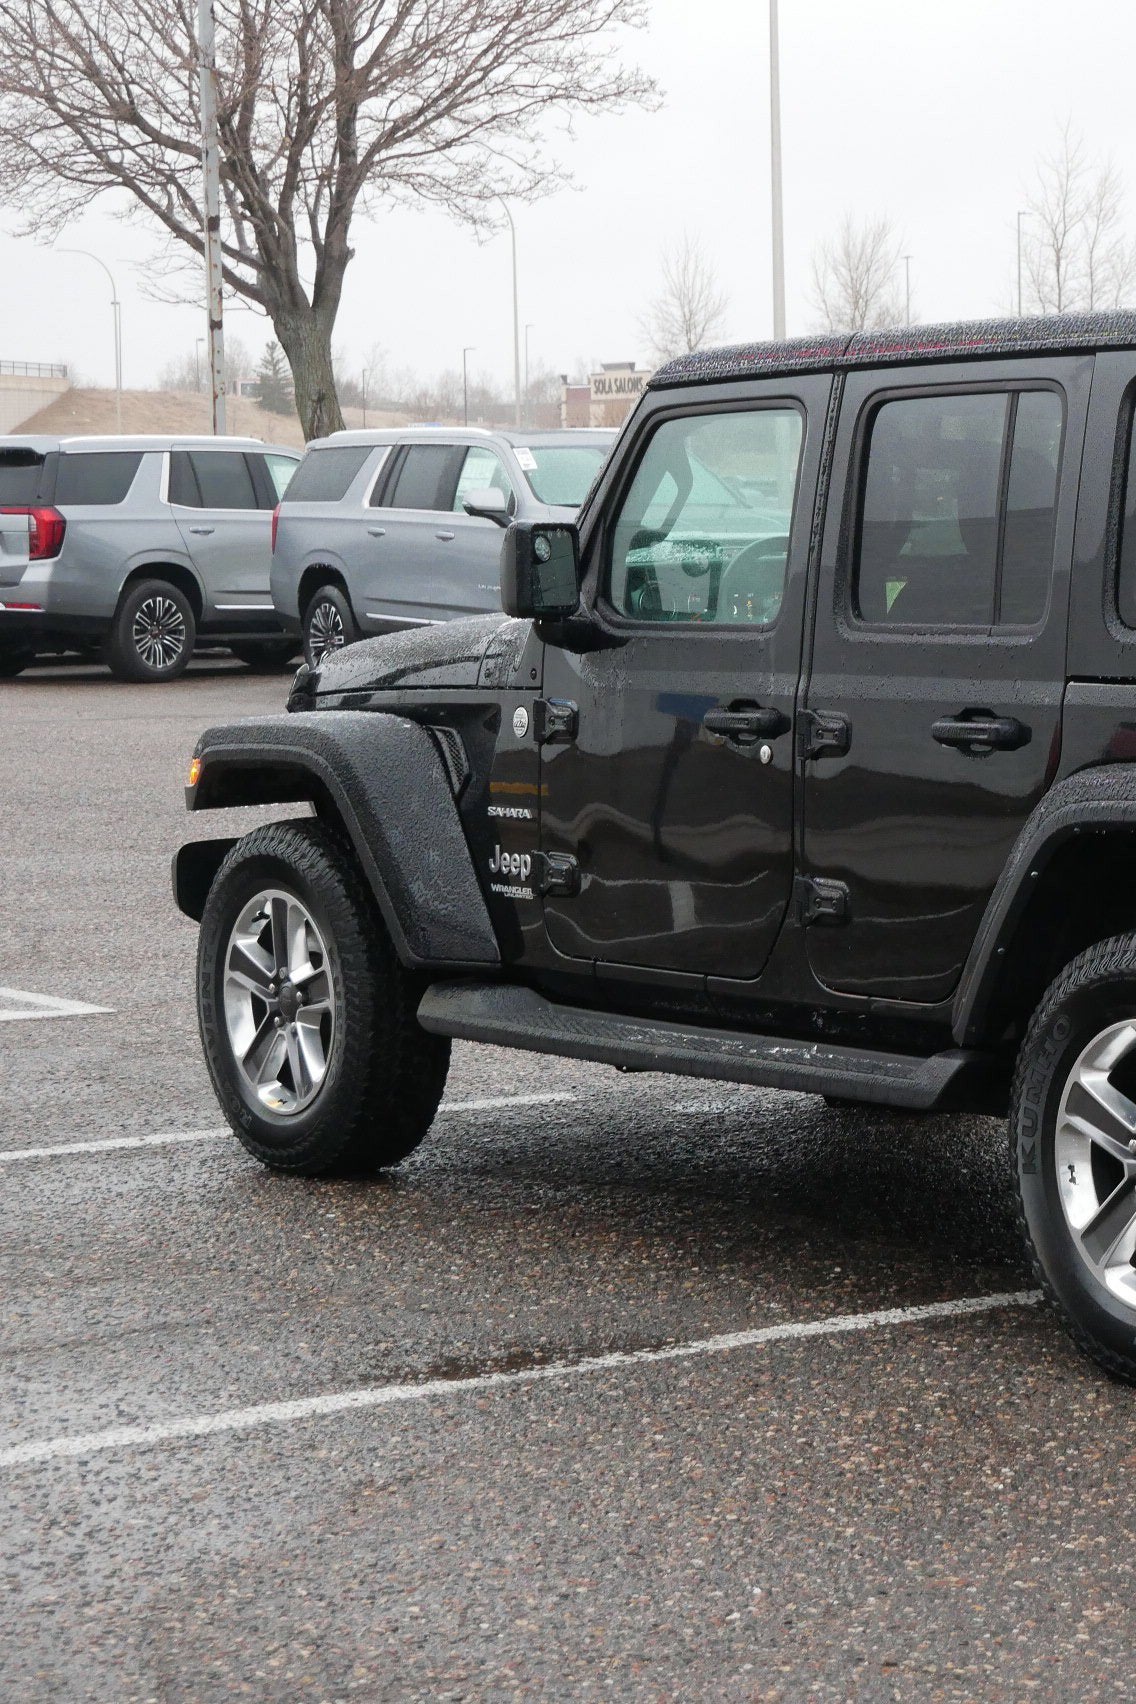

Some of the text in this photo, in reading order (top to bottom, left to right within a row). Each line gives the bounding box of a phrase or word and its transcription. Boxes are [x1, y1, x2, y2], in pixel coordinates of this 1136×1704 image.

[594, 376, 643, 394] SOLA SALONS
[487, 806, 532, 819] SAHARA
[488, 844, 531, 881] Jeep
[490, 883, 533, 897] WRANGLER
[1022, 1014, 1071, 1174] KUMHO
